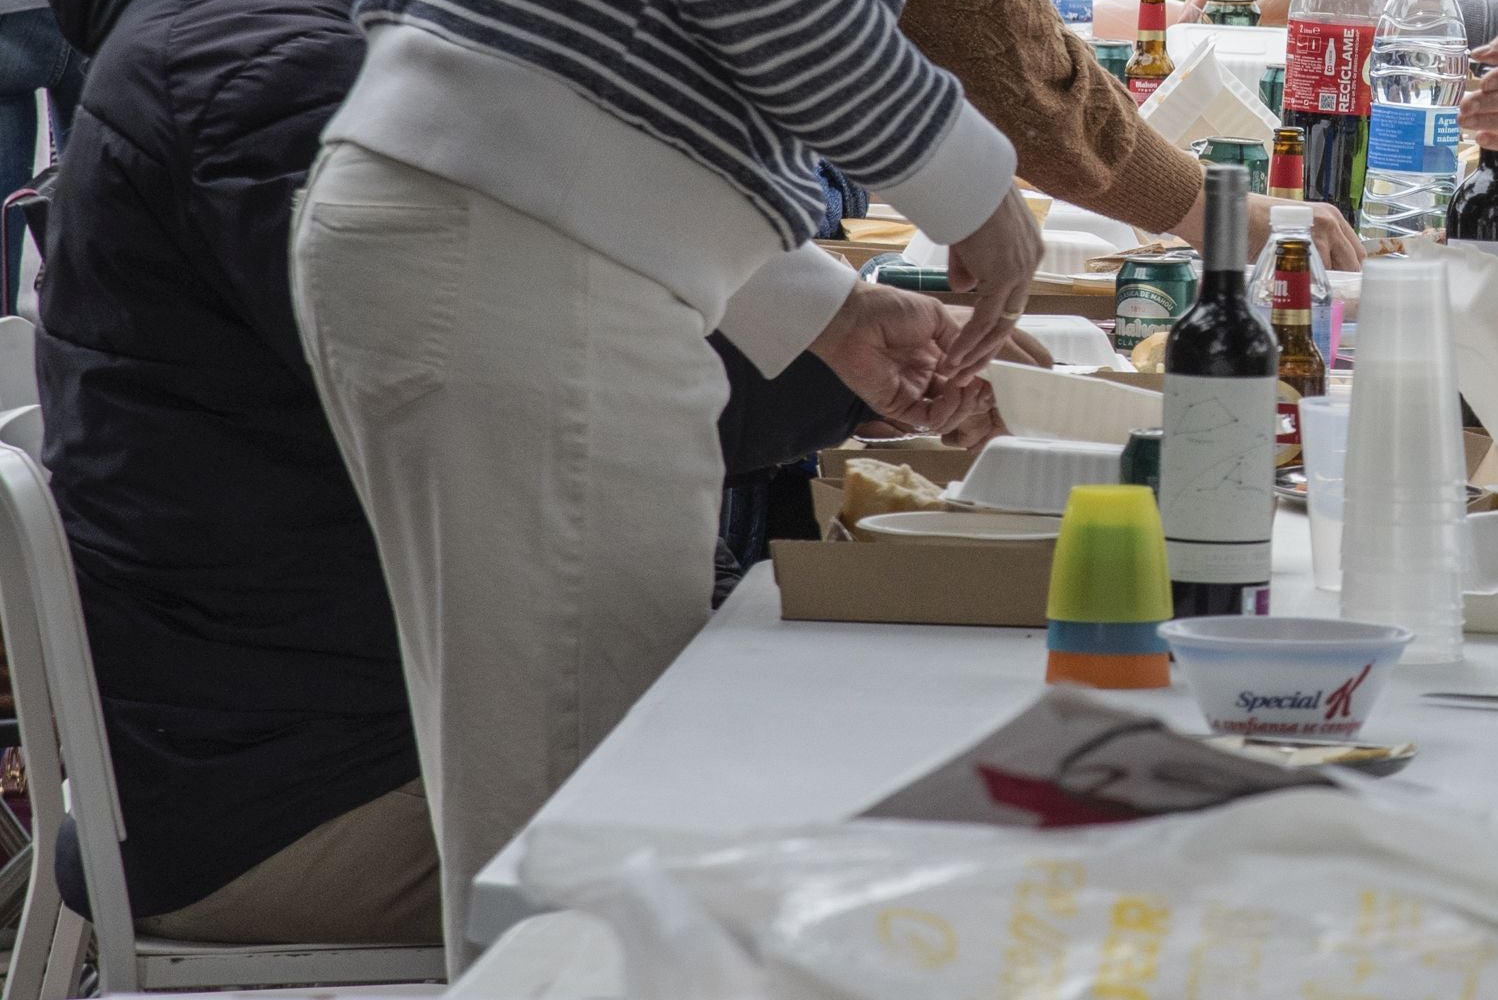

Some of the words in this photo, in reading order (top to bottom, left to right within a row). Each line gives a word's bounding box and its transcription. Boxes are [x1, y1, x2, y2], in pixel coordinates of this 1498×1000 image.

[1337, 28, 1355, 112] RECÍCLAME
[1135, 81, 1158, 89] Mahou
[1438, 117, 1457, 127] Agua
[1139, 290, 1150, 298] DE
[1150, 293, 1174, 311] MAHOU
[1235, 689, 1323, 713] Special
[1324, 658, 1377, 720] K
